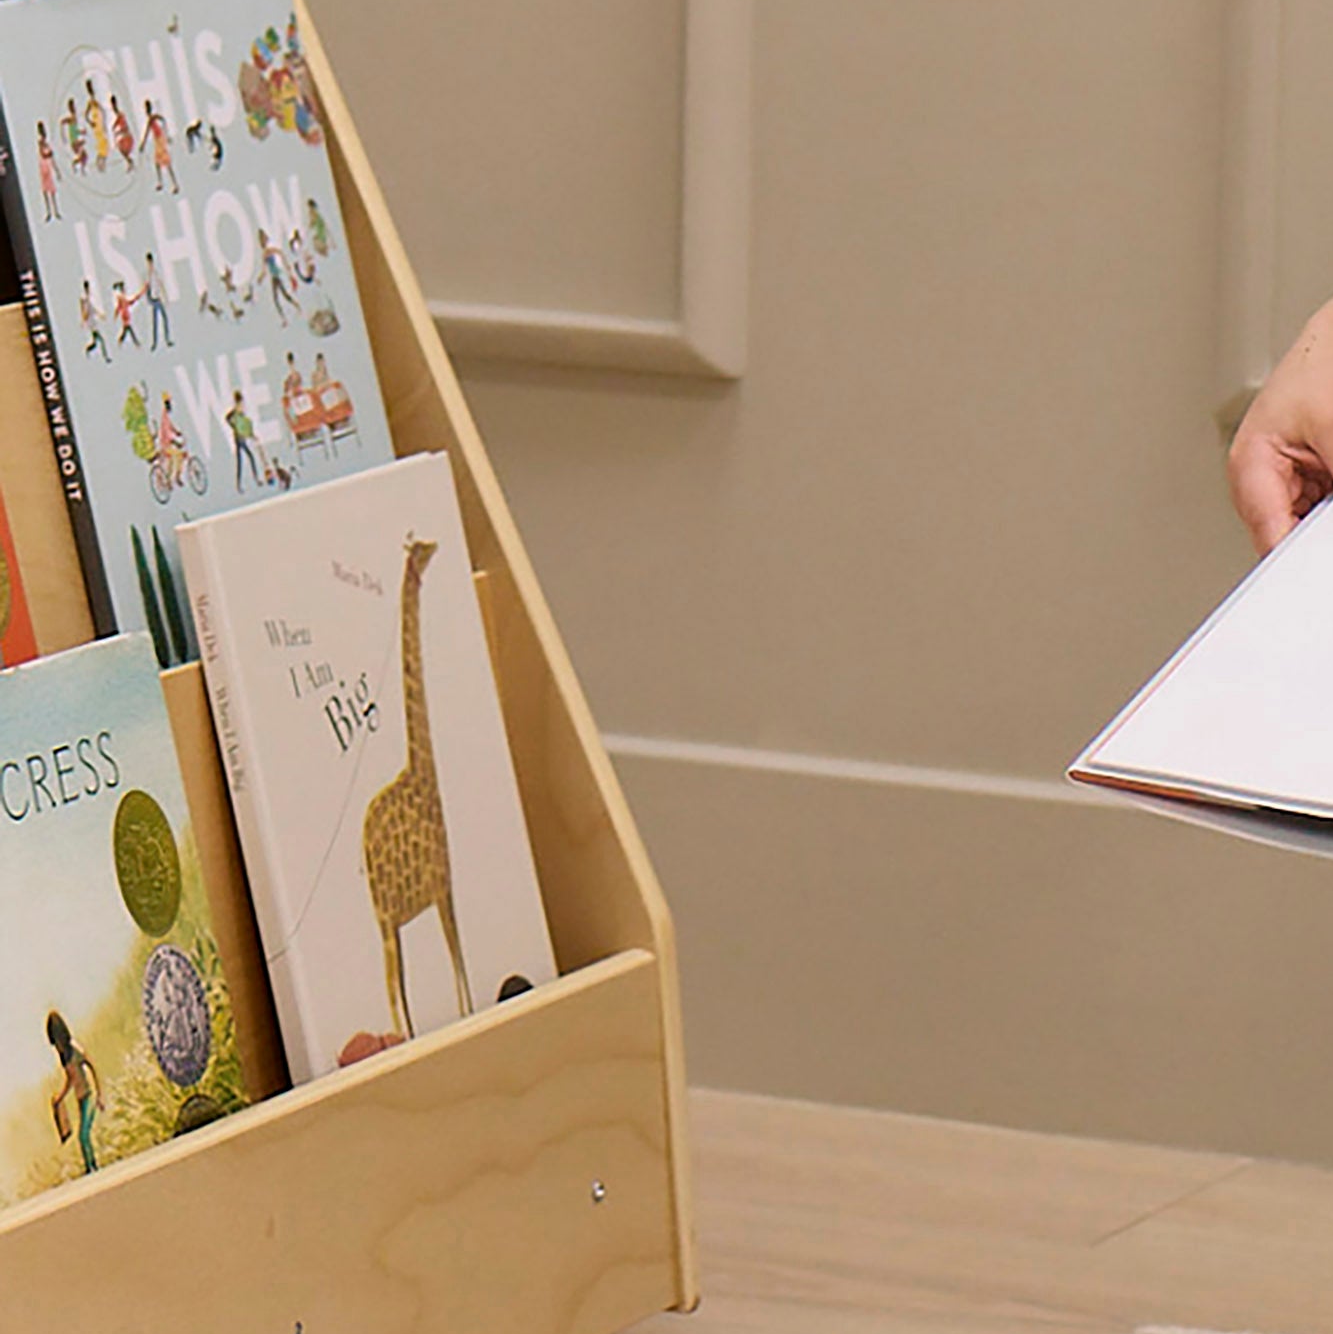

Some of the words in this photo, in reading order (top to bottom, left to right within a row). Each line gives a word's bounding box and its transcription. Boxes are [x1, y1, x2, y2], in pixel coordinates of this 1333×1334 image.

[82, 29, 237, 147] THIS
[74, 213, 143, 311] IS
[151, 174, 305, 303] HOW
[19, 270, 41, 317] THIS
[31, 324, 47, 345] IS
[37, 350, 60, 401] HOW
[51, 407, 69, 438] WE
[176, 346, 282, 458] WE
[58, 444, 76, 476] DO
[66, 482, 82, 502] IT
[264, 619, 312, 647] When
[290, 667, 301, 698] I
[304, 662, 334, 689] Am
[325, 672, 380, 752] Big
[0, 731, 120, 821] CRESS
